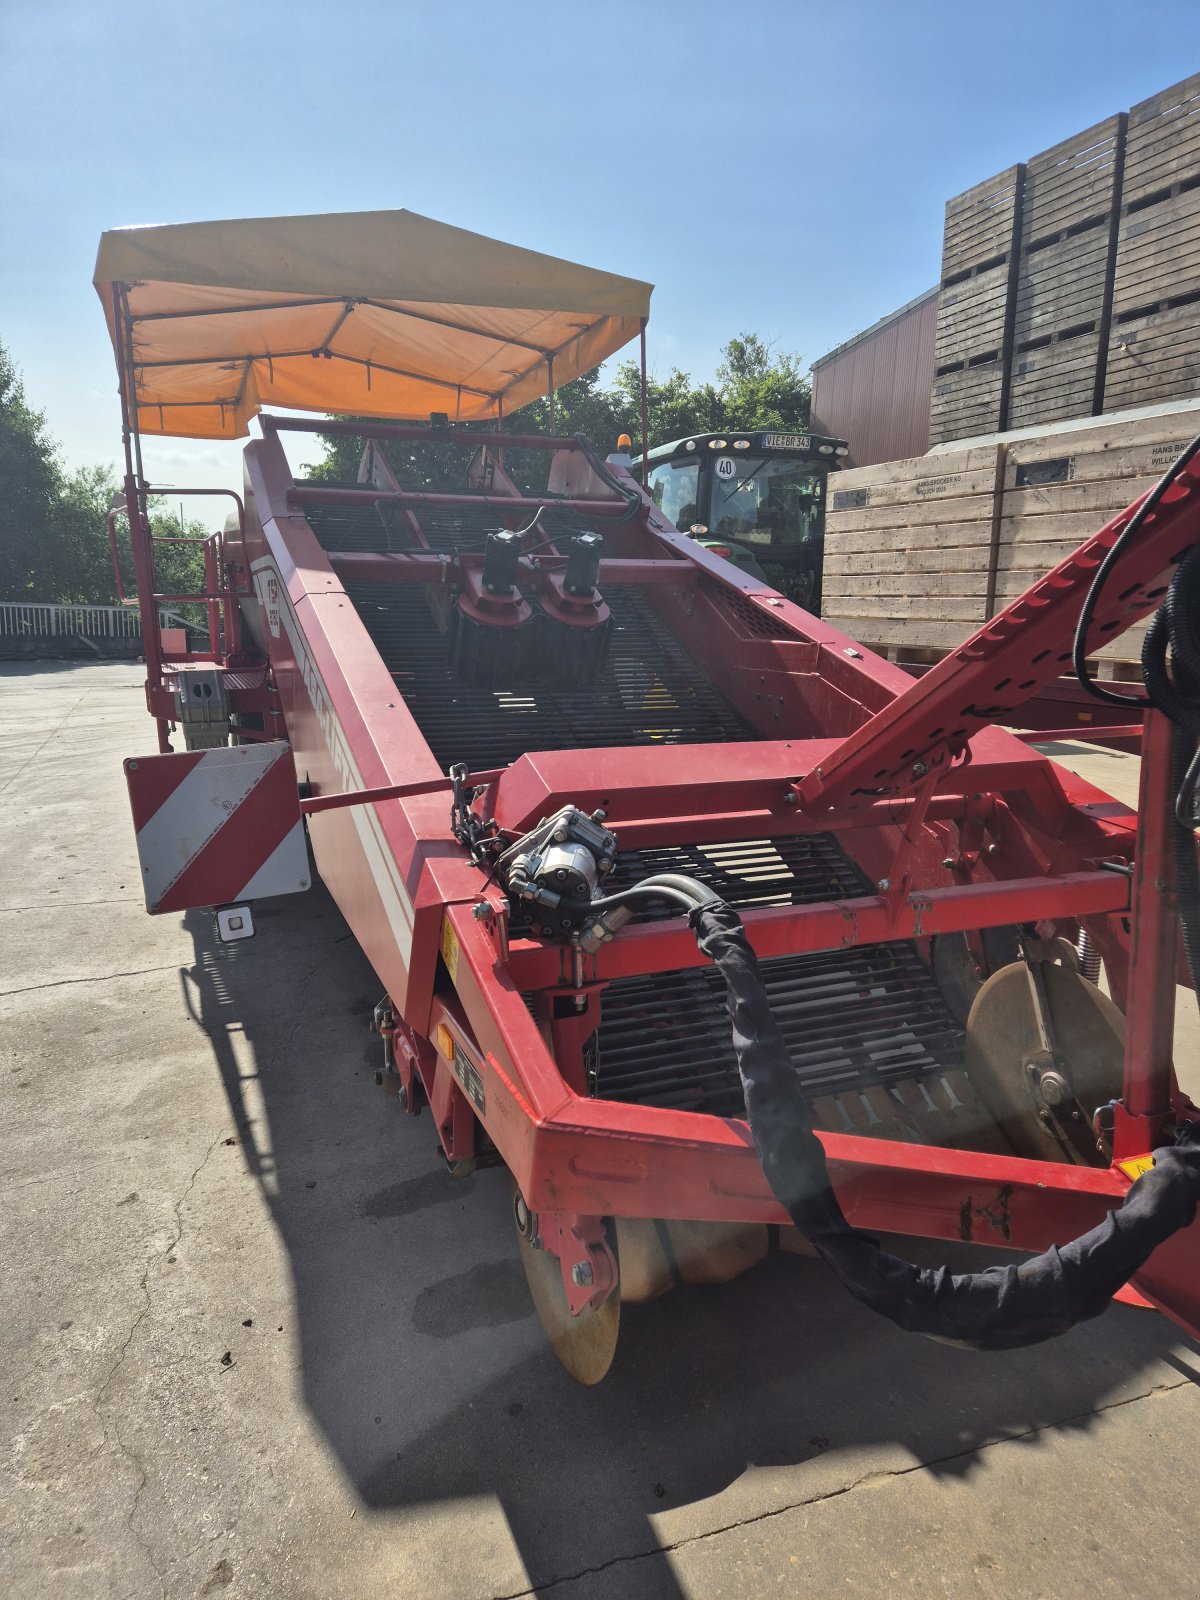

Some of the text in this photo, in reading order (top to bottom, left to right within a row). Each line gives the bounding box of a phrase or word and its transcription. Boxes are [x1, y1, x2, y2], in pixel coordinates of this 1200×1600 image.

[767, 435, 810, 448] VIE BR 343
[1152, 446, 1173, 455] HANS
[719, 460, 732, 475] 40
